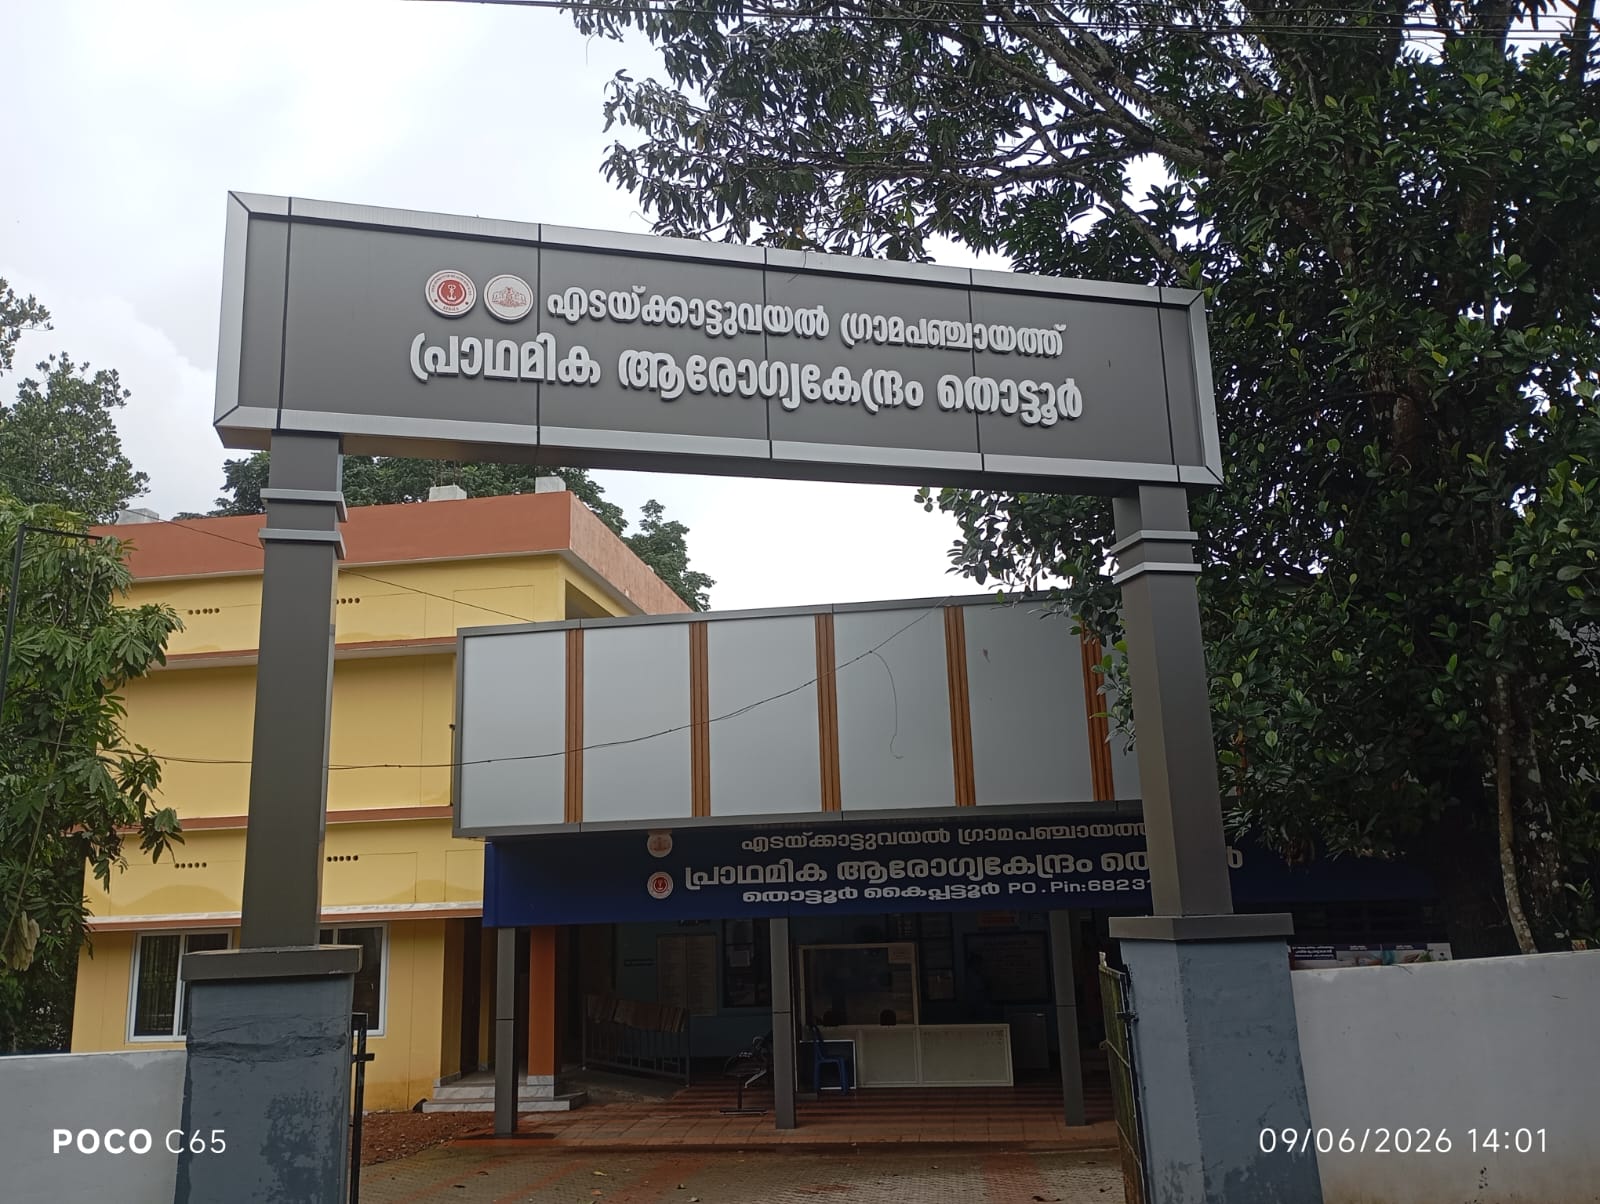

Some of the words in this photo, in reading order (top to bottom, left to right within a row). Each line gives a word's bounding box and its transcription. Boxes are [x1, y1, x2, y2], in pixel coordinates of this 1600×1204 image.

[548, 285, 829, 336] എടയ്ക്കാട്ടുവയൽ
[841, 313, 1066, 355] ഗ്രാമപഞ്ചായത്ത്
[411, 333, 600, 383] പ്രാഥമിക
[619, 350, 923, 411] ആരോഗ്യകേന്ദ്രം
[938, 375, 1082, 425] തൊട്ടൂർ
[742, 829, 950, 852] എടയ്ക്കാട്ടുവയൽ
[686, 859, 827, 889] പ്രാഥമിക
[838, 855, 1092, 883] ആരോഗ്യകേന്ദ്രം
[743, 887, 857, 903] തൊട്ടൂർ
[865, 883, 999, 900] കൈപ്പട്ടൂർ
[1051, 878, 1151, 893] Pin:6823
